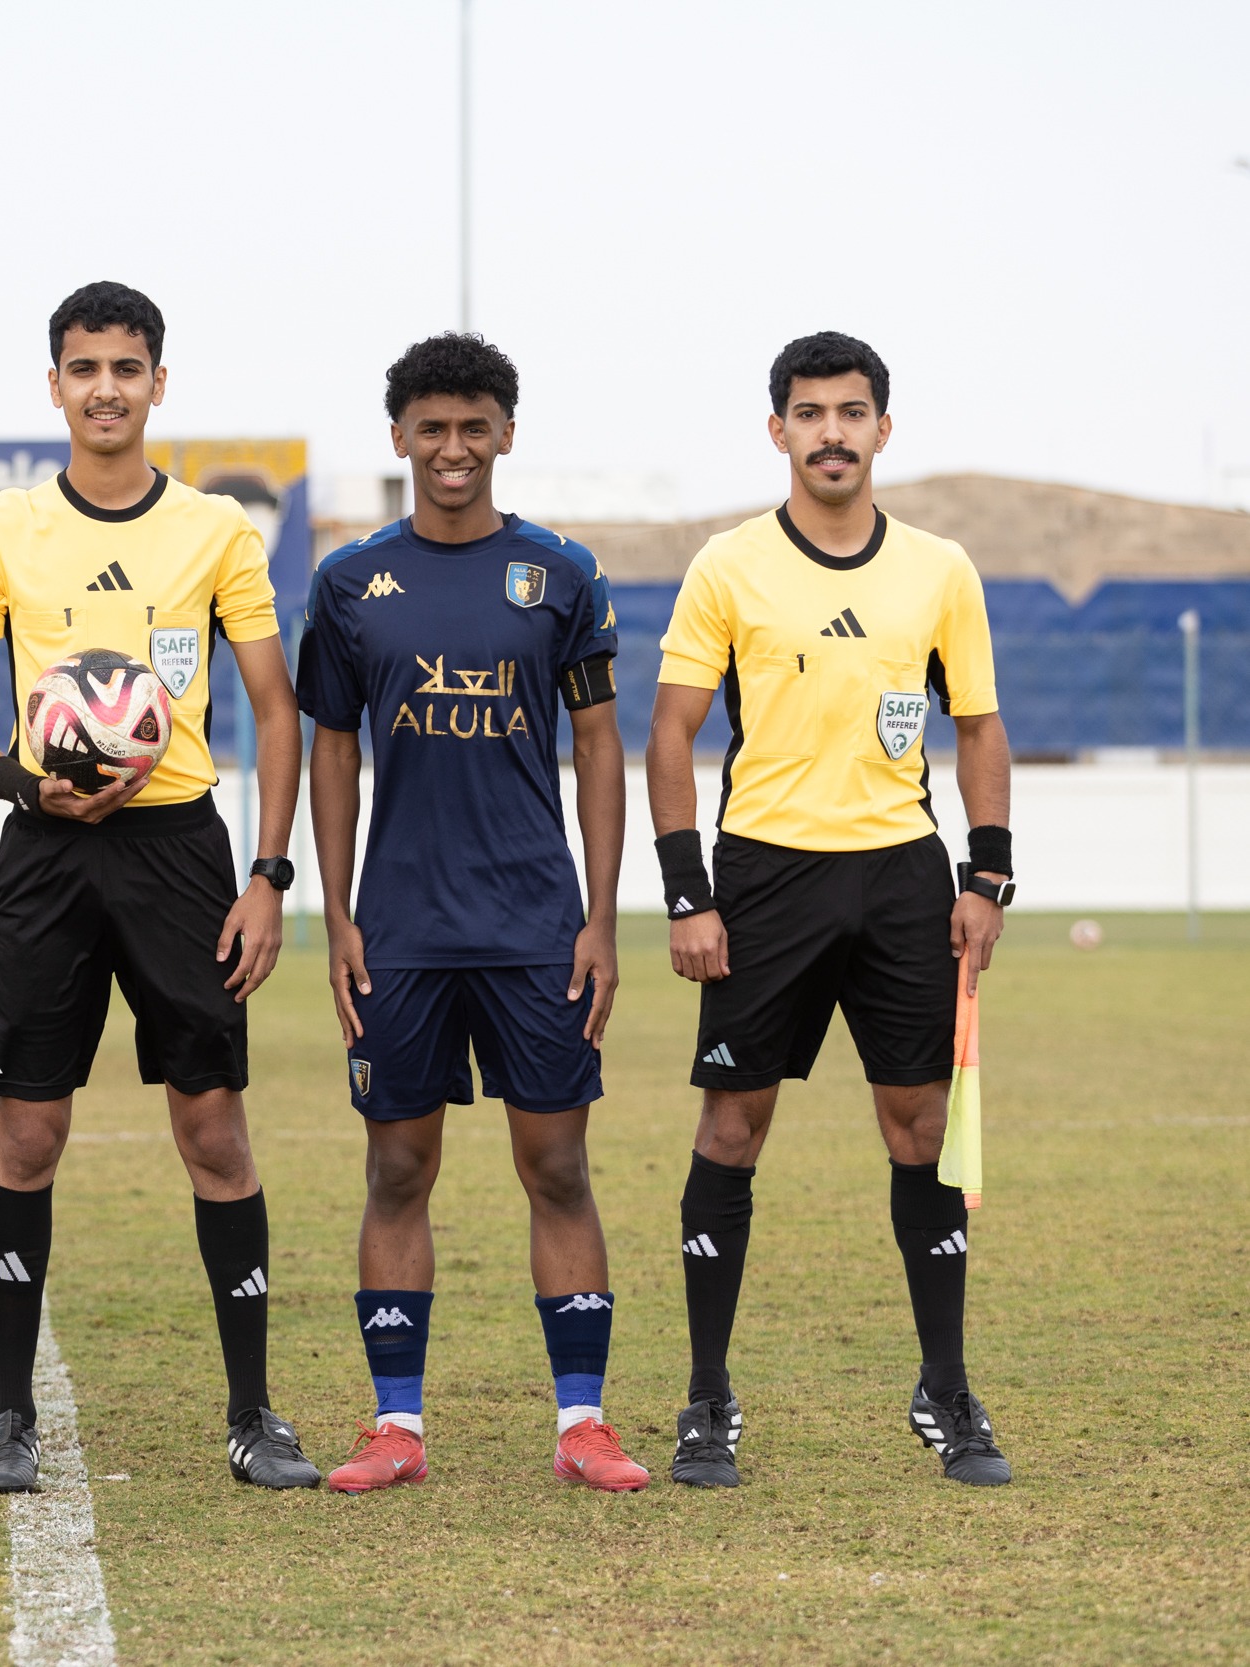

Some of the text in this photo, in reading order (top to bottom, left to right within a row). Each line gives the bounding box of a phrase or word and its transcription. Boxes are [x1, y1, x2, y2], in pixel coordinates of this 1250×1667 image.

[156, 637, 196, 655] SAFF
[161, 657, 194, 666] REFEREE
[884, 700, 924, 718] SAFF
[390, 702, 529, 740] ALULA
[886, 720, 919, 730] REFEREE
